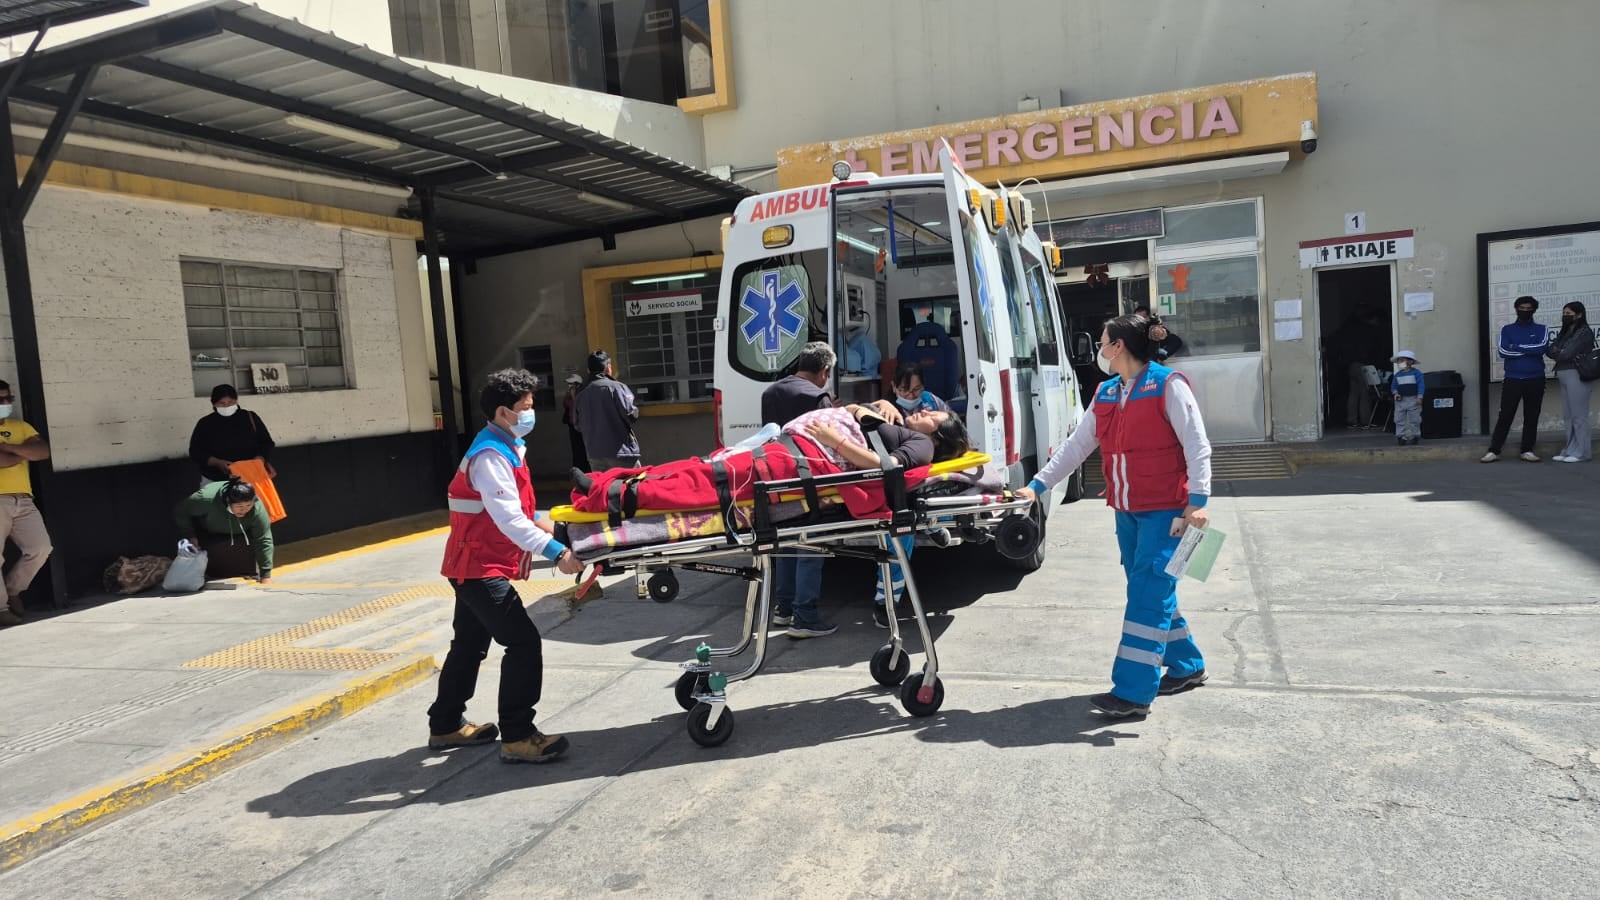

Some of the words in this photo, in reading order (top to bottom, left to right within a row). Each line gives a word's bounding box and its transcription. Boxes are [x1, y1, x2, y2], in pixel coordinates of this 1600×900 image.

[881, 96, 1240, 177] EMERGENCIA
[1351, 215, 1359, 229] 1
[1334, 240, 1397, 260] TRIAJE
[647, 302, 675, 310] SERVICIO
[1160, 296, 1172, 315] 4
[260, 367, 279, 381] NO
